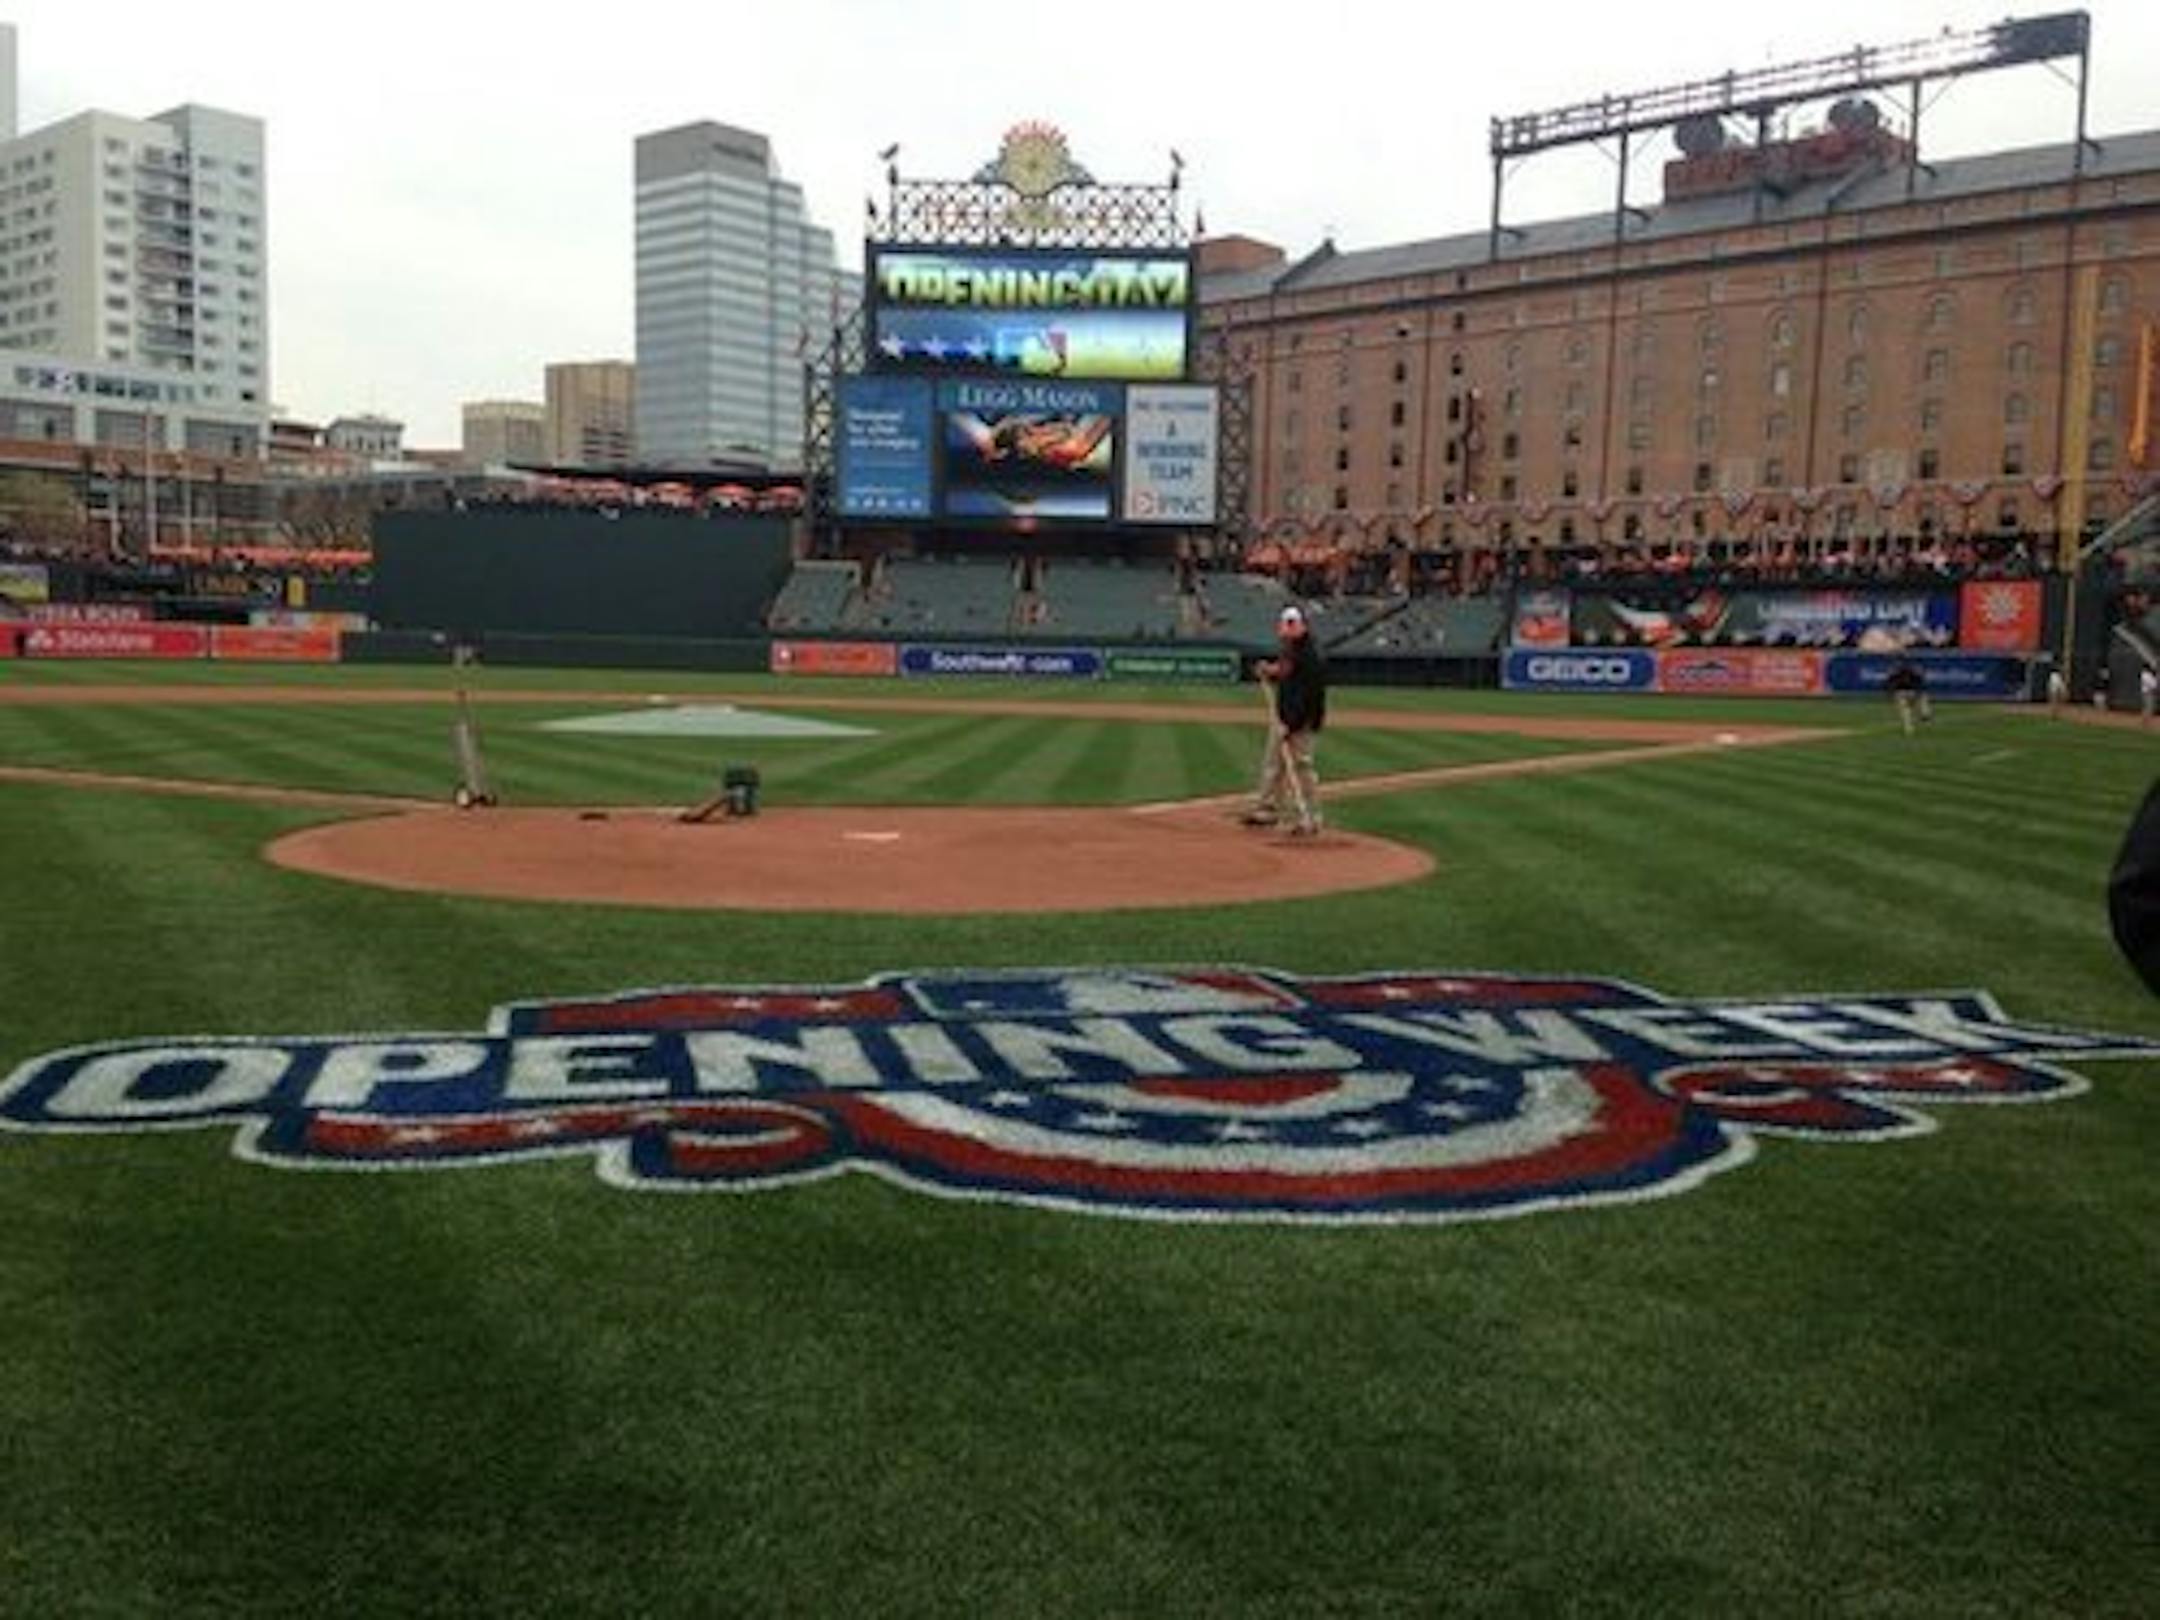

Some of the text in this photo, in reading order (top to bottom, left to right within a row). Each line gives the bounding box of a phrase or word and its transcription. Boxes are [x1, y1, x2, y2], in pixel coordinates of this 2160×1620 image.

[1527, 658, 1631, 682] GEICO
[40, 997, 1992, 1115] OPENING WEEK
